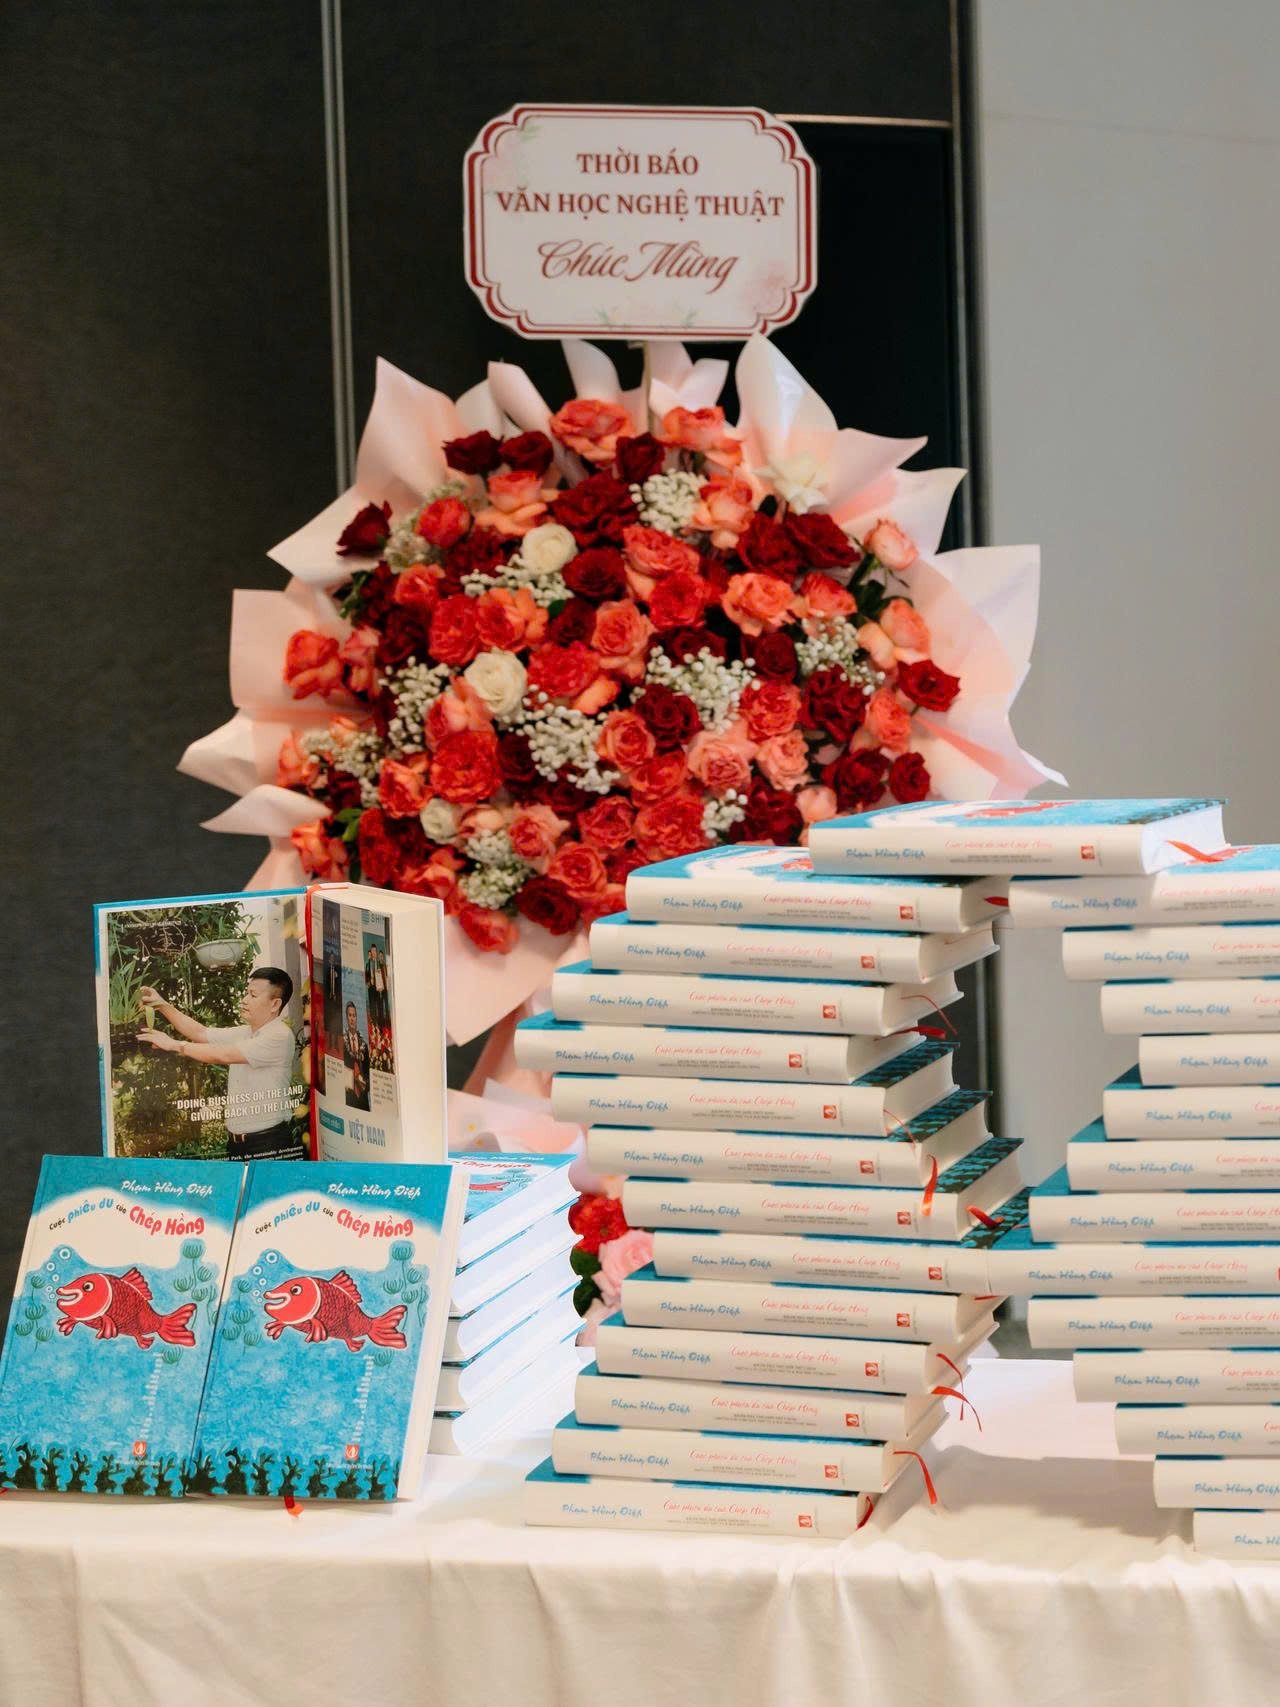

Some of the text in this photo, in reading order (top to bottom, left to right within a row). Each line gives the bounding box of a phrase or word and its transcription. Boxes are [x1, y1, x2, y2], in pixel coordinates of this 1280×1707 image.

[577, 147, 699, 175] THỜI BÁO
[497, 187, 784, 222] VĂN HỌC NGHỆ THUẬT
[538, 239, 739, 295] Chúc Mừng
[208, 1093, 250, 1106] BUSINESS
[253, 1091, 264, 1101] ON
[266, 1088, 282, 1098] THE
[283, 1084, 303, 1096] LAND
[190, 1110, 222, 1122] GIVING
[224, 1106, 248, 1118] BACK
[250, 1104, 261, 1114] TO
[263, 1102, 278, 1112] THE
[349, 1119, 364, 1144] VIỆT
[366, 1125, 385, 1147] NAM
[120, 1180, 212, 1198] Phạm Hồng Điệp
[327, 1183, 421, 1200] Phạm Hồng Điệp
[67, 1200, 95, 1223] phiêu
[130, 1205, 162, 1235] Chép
[164, 1213, 204, 1235] Hồng
[273, 1204, 302, 1227] phiêu
[337, 1209, 370, 1238] Chép
[373, 1215, 414, 1237] Hồng
